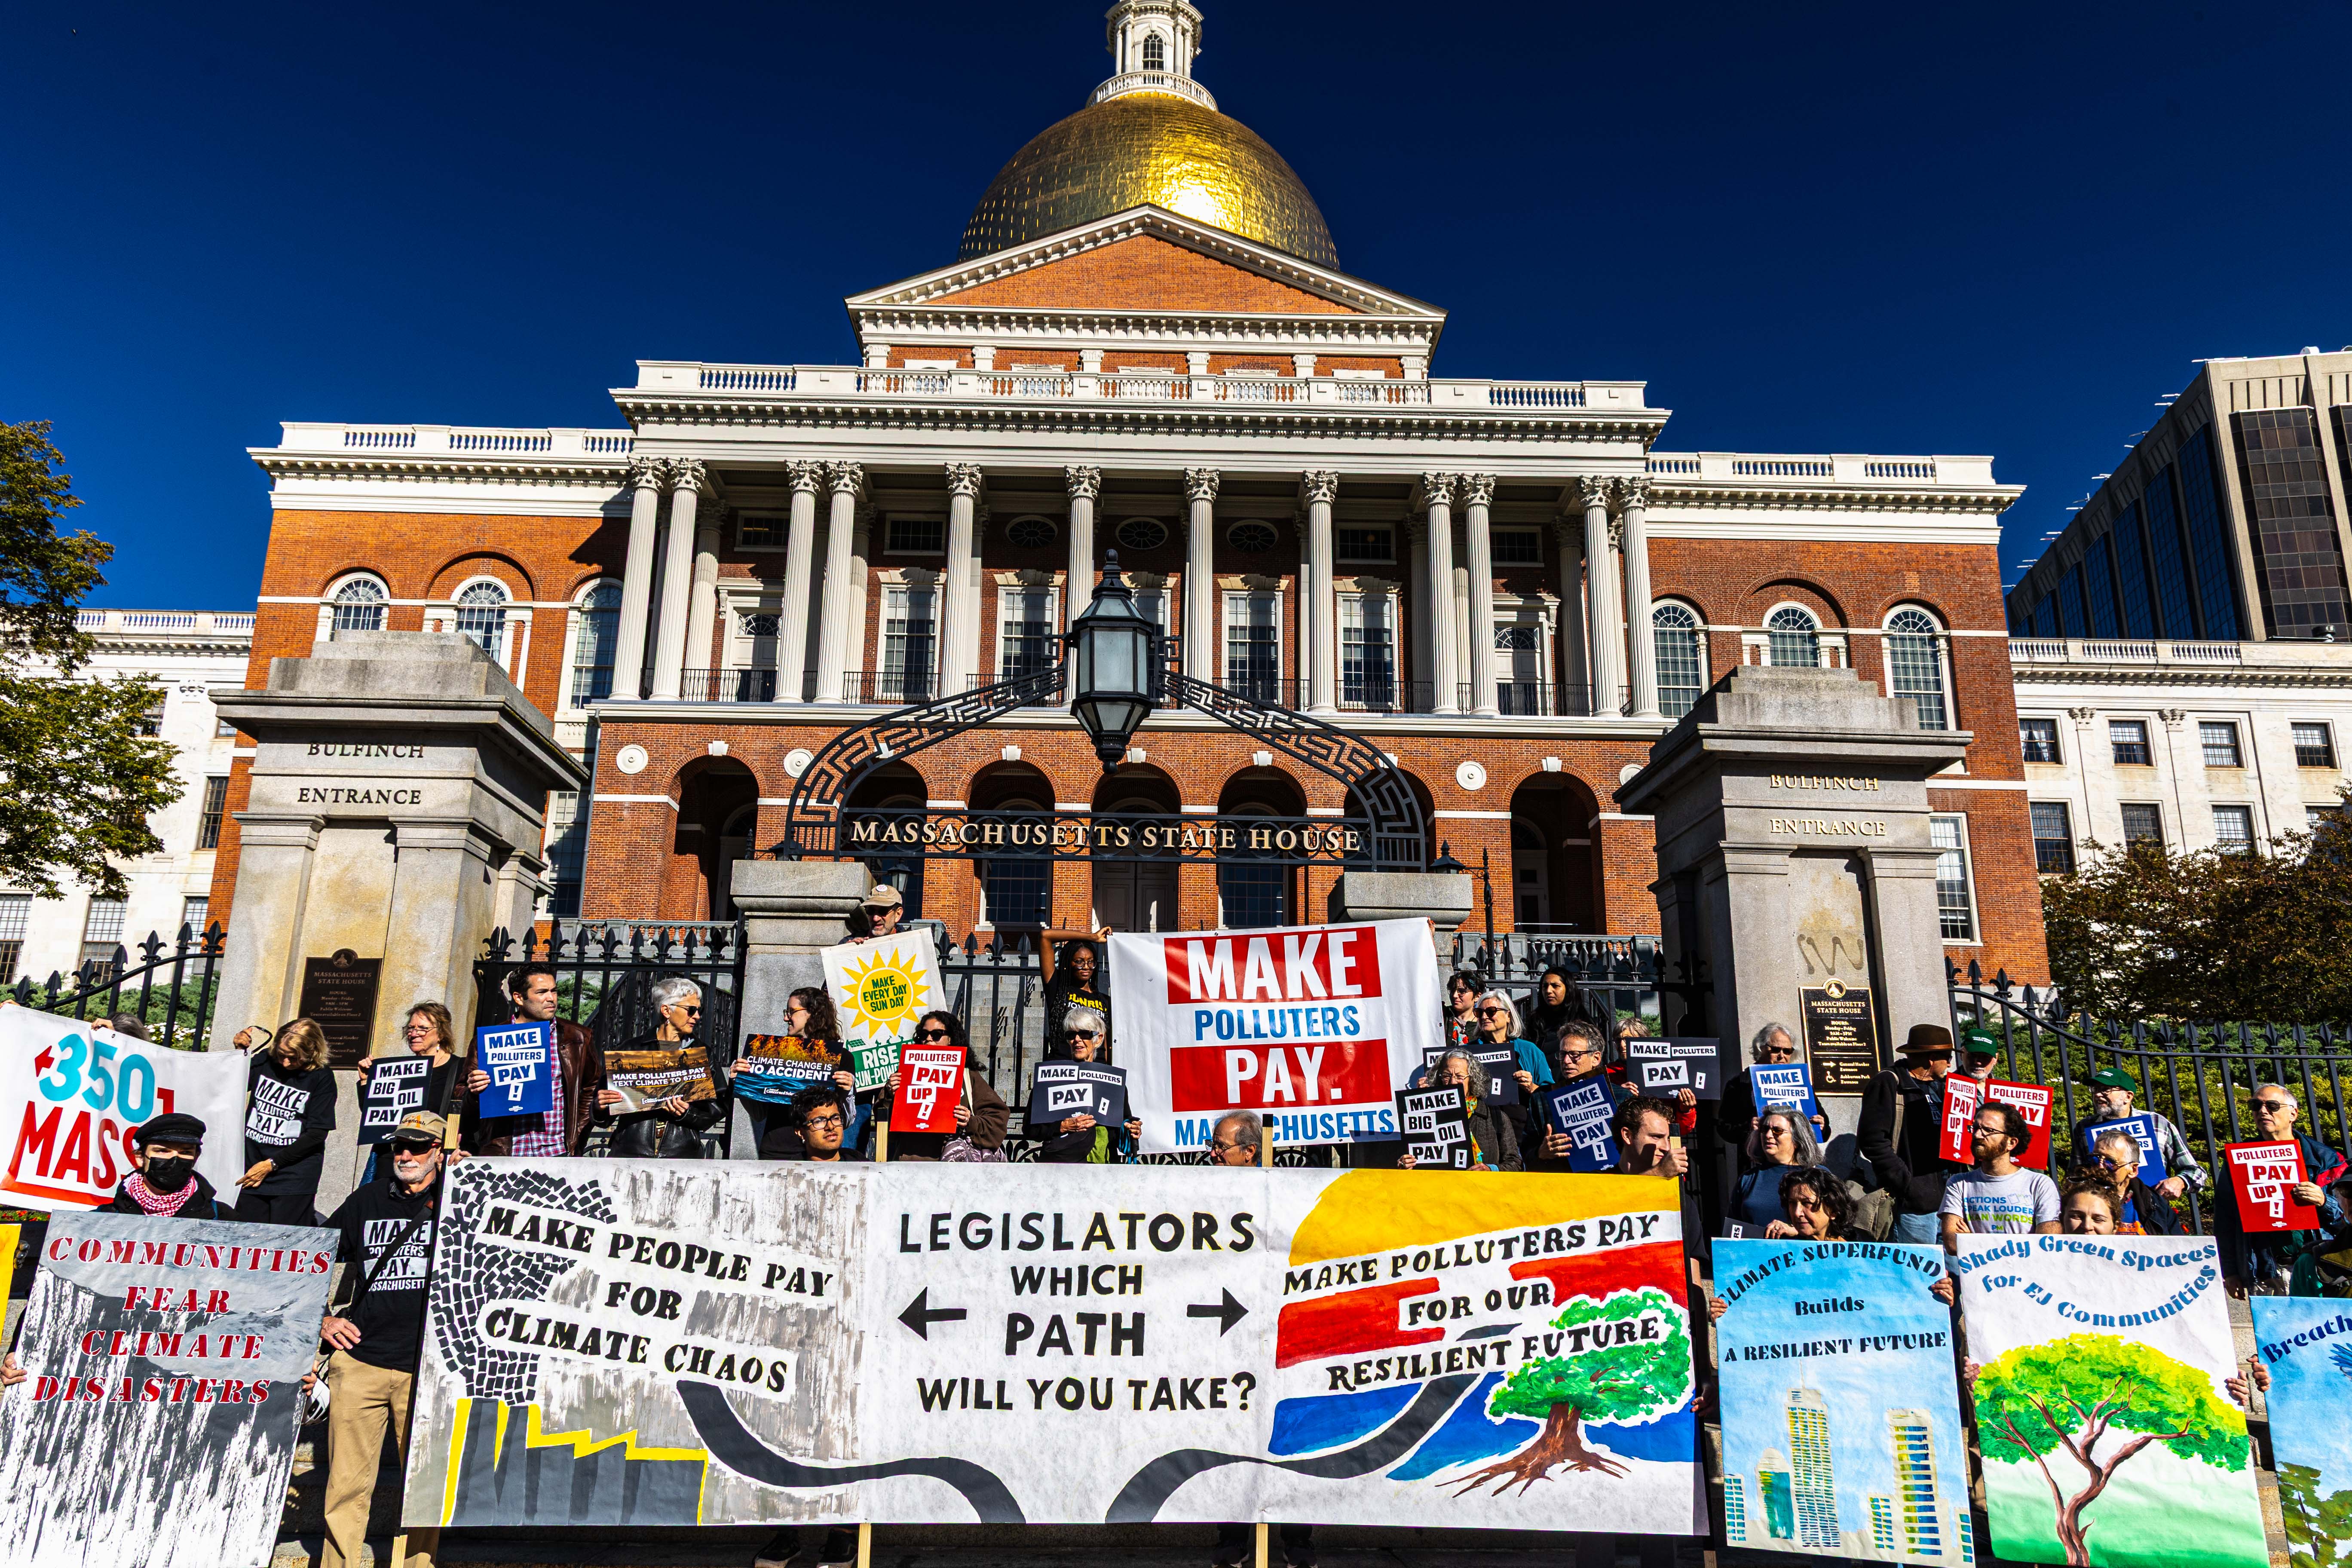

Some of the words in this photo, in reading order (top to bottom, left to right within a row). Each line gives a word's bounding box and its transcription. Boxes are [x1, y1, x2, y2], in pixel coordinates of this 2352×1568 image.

[307, 742, 424, 758] BULFINCH
[1770, 775, 1879, 791] BULFINCH
[297, 787, 422, 805] ENTRANCE
[1770, 818, 1887, 836] ENTRANCE
[851, 821, 1130, 847] MASSACHUSETTS
[1142, 826, 1236, 850] STATE
[1250, 830, 1361, 852] HOUSE
[1187, 931, 1362, 1000] MAKE
[871, 975, 895, 989] MAKE
[863, 989, 890, 1002] EVERY
[893, 984, 907, 996] DAY
[870, 1000, 888, 1012] SUN
[891, 996, 904, 1008] DAY
[1194, 1005, 1360, 1041] POLLUTERS
[488, 1032, 537, 1049] MAKE
[491, 1051, 542, 1061] POLLUTERS
[862, 1045, 899, 1069] RISE
[908, 1053, 958, 1062] POLLUTERS
[1633, 1045, 1668, 1055] MAKE
[380, 1063, 424, 1078] MAKE
[747, 1056, 784, 1066] CLIMATE
[786, 1060, 822, 1070] CHANGE
[39, 1033, 155, 1123] 350
[498, 1065, 530, 1082] PAY
[639, 1070, 687, 1079] POLLUTERS
[683, 1073, 706, 1081] 67369
[766, 1066, 831, 1081] ACCIDENT
[916, 1067, 952, 1084] PAY
[1040, 1069, 1075, 1078] MAKE
[1081, 1072, 1121, 1083] POLLUTERS
[1225, 1046, 1343, 1104] PAY.
[1647, 1066, 1682, 1082] PAY
[1760, 1072, 1800, 1084] MAKE
[256, 1079, 307, 1111] MAKE
[373, 1082, 395, 1094] BIG
[911, 1088, 932, 1100] UP
[1053, 1088, 1088, 1106] PAY
[1764, 1088, 1805, 1096] POLLUTERS
[1950, 1081, 1974, 1095] POLLUTERS
[1994, 1088, 2044, 1101] POLLUTERS
[398, 1091, 418, 1105] OIL
[1409, 1092, 1456, 1112] MAKE
[1558, 1087, 1600, 1112] MAKE
[1954, 1097, 1971, 1116] PAY
[368, 1109, 399, 1122] PAY
[1409, 1115, 1432, 1130] BIG
[1565, 1106, 1610, 1124] POLLUTERS
[1950, 1117, 1960, 1129] UP
[255, 1114, 285, 1136] PAY.
[1175, 1109, 1394, 1146] MACHUSETTS
[1438, 1124, 1461, 1141] OIL
[1575, 1121, 1607, 1145] PAY
[1412, 1145, 1444, 1160] PAY
[2236, 1148, 2292, 1161] POLLUTERS
[2252, 1166, 2292, 1179] PAY
[2252, 1185, 2277, 1199] UP
[1992, 1213, 2033, 1225] WORDS
[1994, 1205, 2034, 1216] LOUDER
[899, 1211, 1256, 1253] LEGISLATORS
[48, 1236, 332, 1275] COMMUNITIES
[484, 1206, 595, 1253] MAKE
[607, 1232, 751, 1282] PEOPLE
[762, 1262, 833, 1297] PAY
[1283, 1258, 1377, 1295] MAKE
[1391, 1223, 1586, 1278] POLLUTERS
[1597, 1214, 1660, 1246] PAY
[1802, 1243, 1941, 1278] SUPERFUND
[1958, 1239, 2030, 1274] Shady
[2039, 1235, 2115, 1262] Green
[2121, 1243, 2217, 1272] Spaces
[1011, 1264, 1144, 1297] WHICH
[123, 1285, 231, 1314] FEAR
[604, 1281, 683, 1321] FOR
[1407, 1296, 1473, 1326] FOR
[1484, 1282, 1551, 1312] OUR
[1982, 1275, 2022, 1293] for
[2023, 1282, 2053, 1306] EJ
[2058, 1264, 2217, 1327] Communities
[1795, 1296, 1865, 1316] Builds
[1005, 1312, 1145, 1357] PATH
[80, 1329, 265, 1360] CLIMATE
[485, 1307, 652, 1364] CLIMATE
[664, 1343, 787, 1393] CHAOS
[1724, 1348, 1737, 1362] A
[1744, 1339, 1853, 1361] RESILIENT
[1860, 1332, 1946, 1353] FUTURE
[1325, 1339, 1512, 1392] RESILIENT
[1521, 1316, 1660, 1360] FUTURE
[31, 1375, 271, 1404] DISASTERS
[916, 1376, 1014, 1413] WILL
[1026, 1376, 1113, 1412] YOU
[1127, 1371, 1257, 1412] TAKE?
